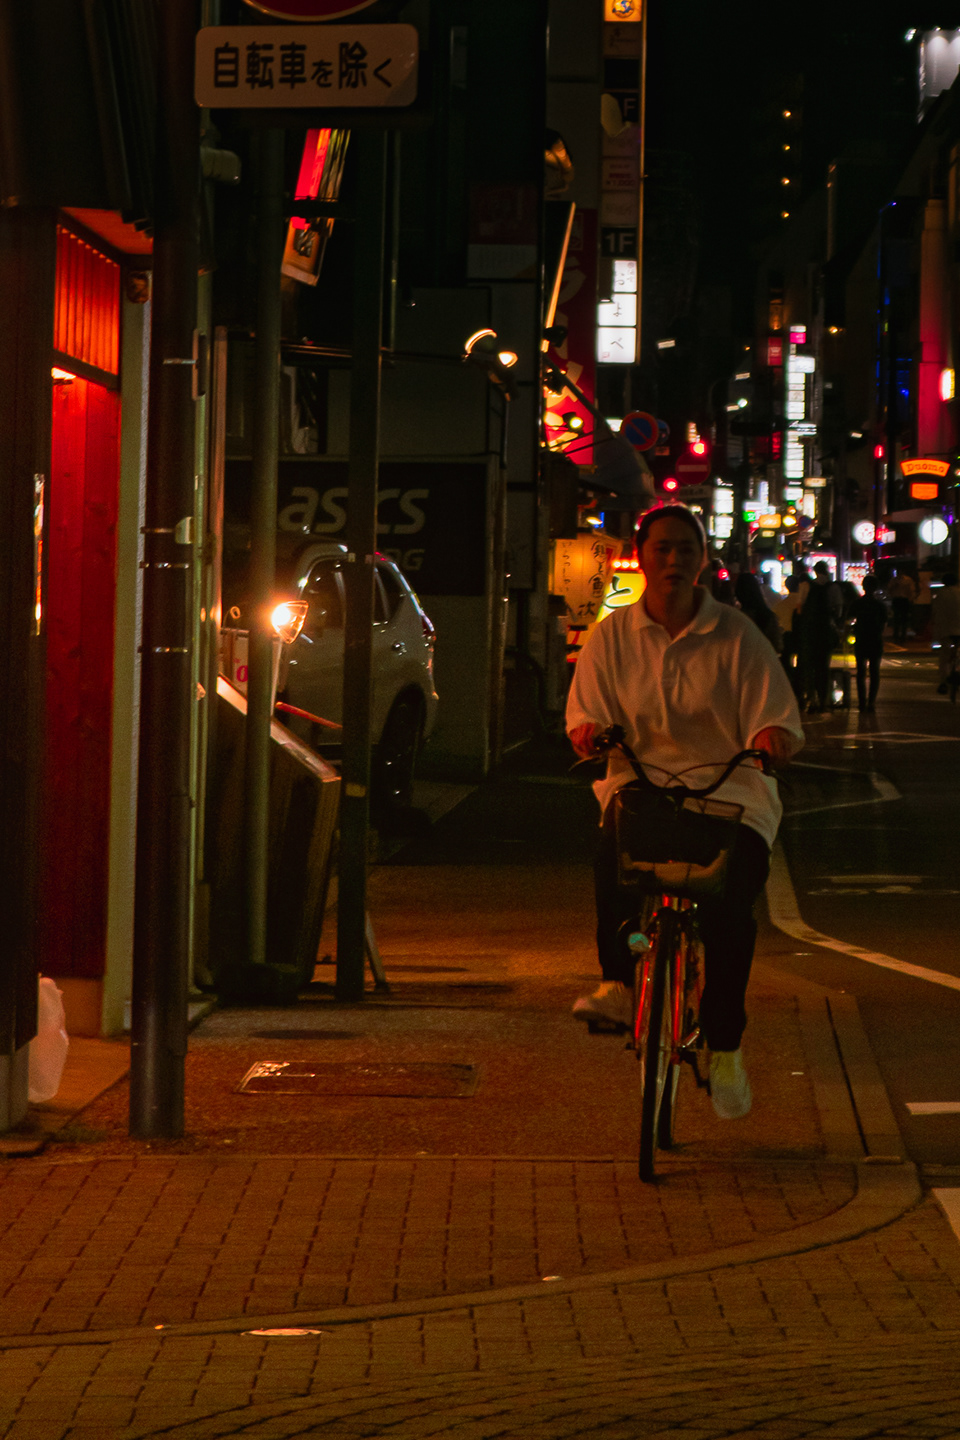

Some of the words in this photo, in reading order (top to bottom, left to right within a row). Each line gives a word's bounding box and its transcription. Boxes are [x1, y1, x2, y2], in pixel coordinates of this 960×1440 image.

[214, 41, 392, 90] 自転車を除く
[605, 232, 635, 253] 1F
[277, 486, 430, 535] ascs
